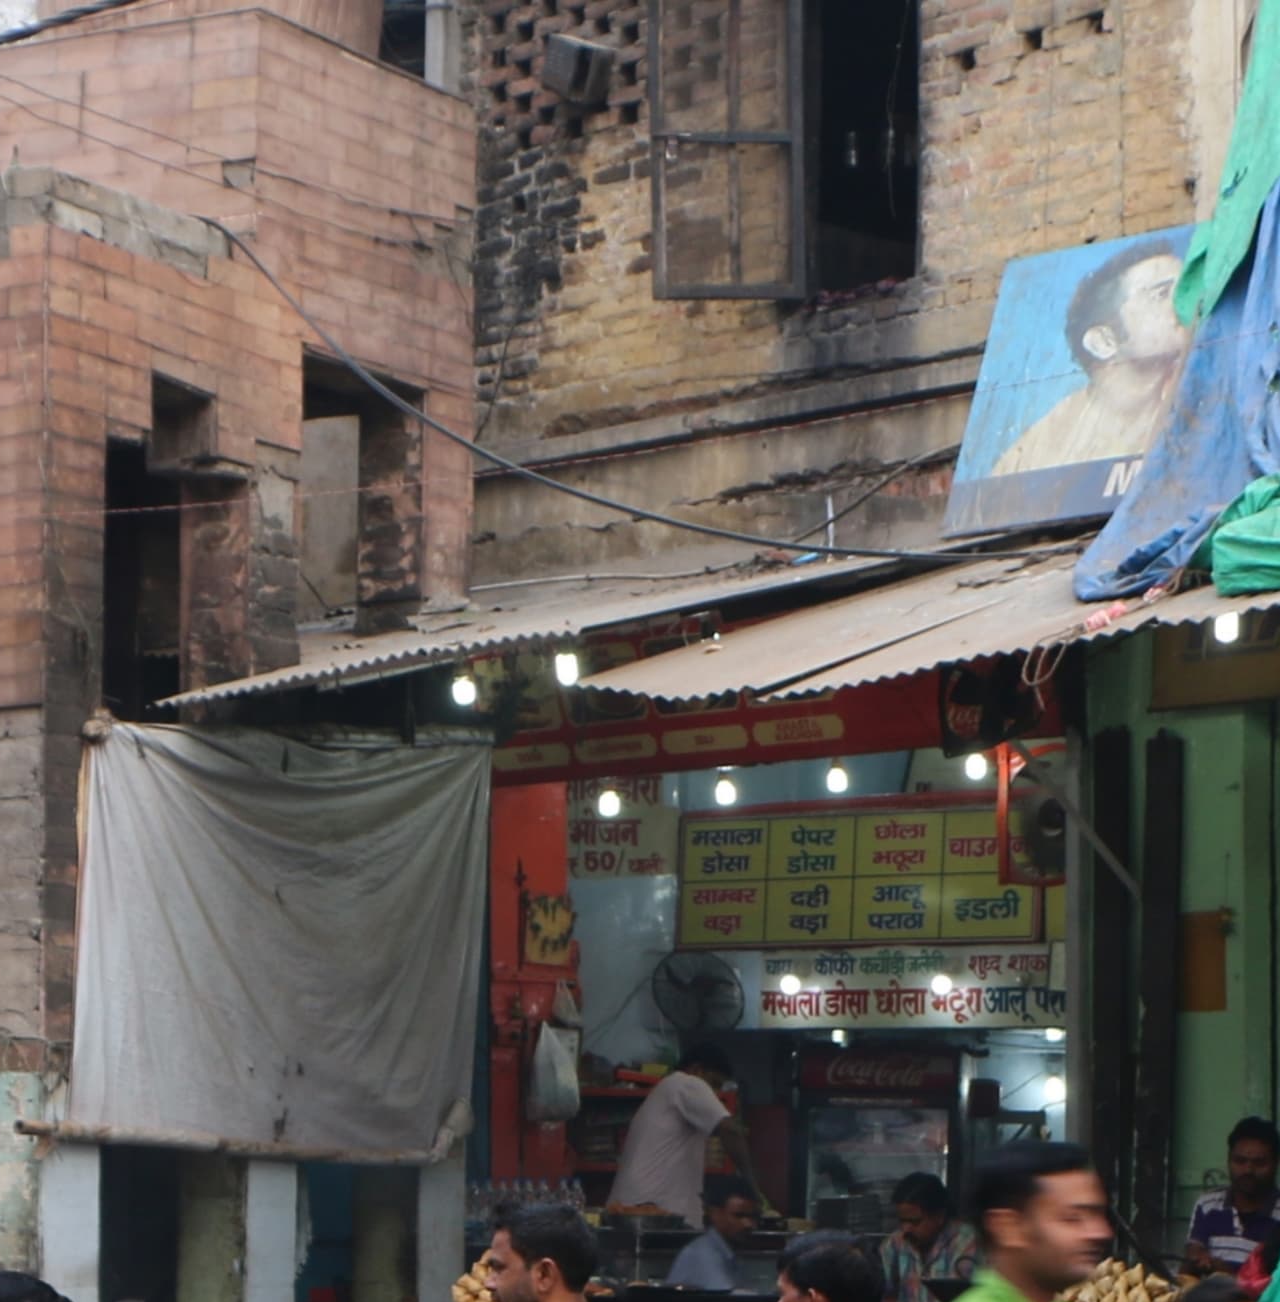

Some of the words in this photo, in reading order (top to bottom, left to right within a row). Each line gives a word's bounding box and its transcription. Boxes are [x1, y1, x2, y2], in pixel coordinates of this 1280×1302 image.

[569, 807, 642, 848] भोजन
[691, 827, 763, 846] मसाला
[790, 824, 837, 846] पेपर
[874, 819, 929, 841] छोला
[701, 850, 751, 875] डोसा
[786, 850, 837, 875] डोसा
[789, 884, 830, 908] दही
[874, 882, 927, 911] आलू
[954, 888, 1021, 922] इडली
[867, 911, 925, 931] पराठा
[760, 987, 822, 1018] मसाला
[822, 979, 870, 1019] डोसा
[984, 986, 1036, 1023] आलू
[1032, 987, 1067, 1018] परा
